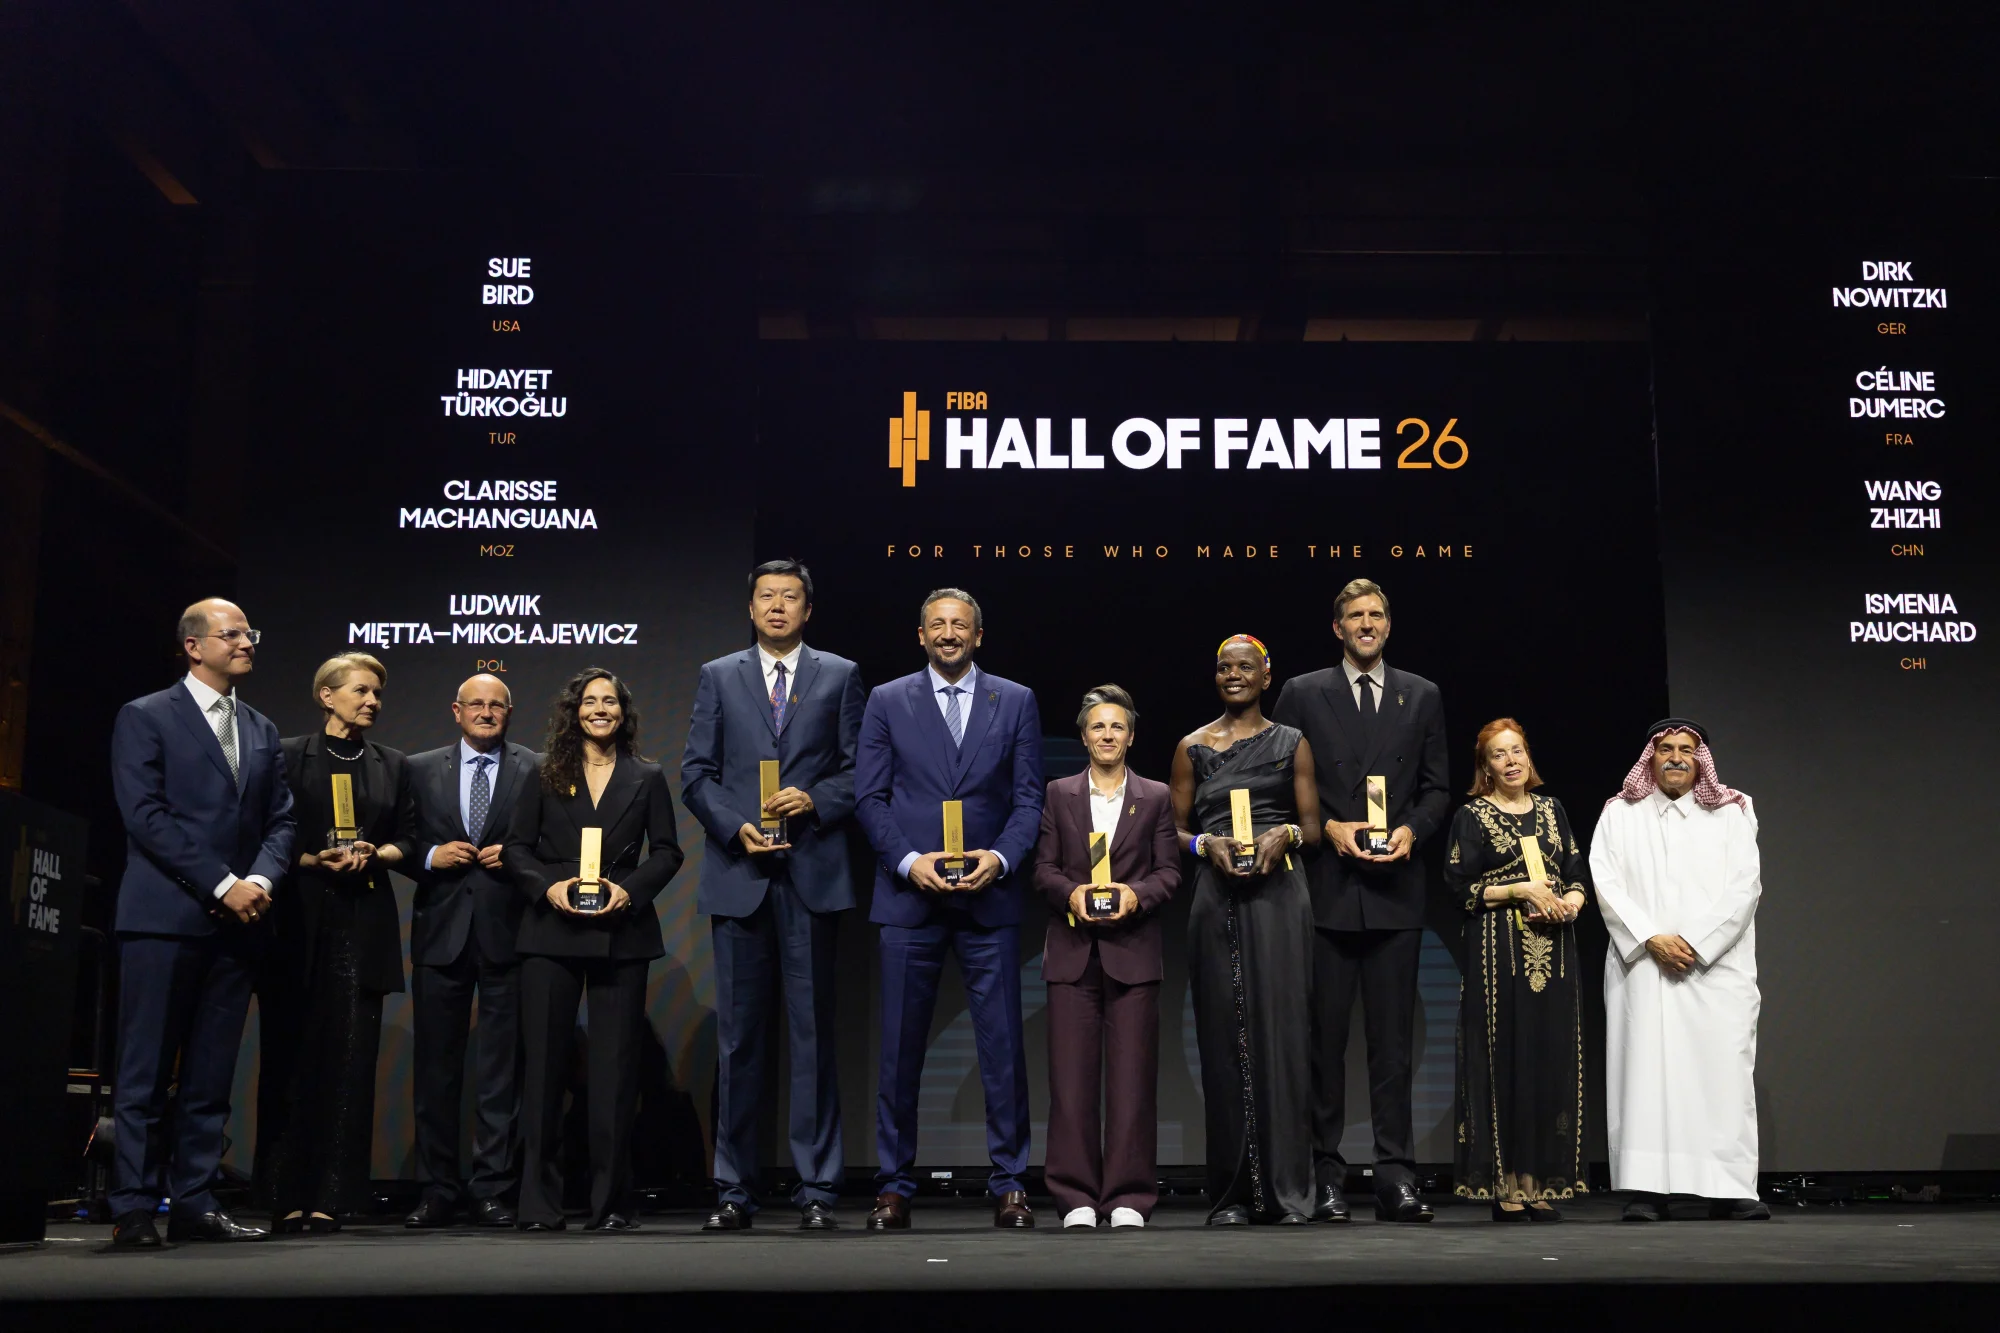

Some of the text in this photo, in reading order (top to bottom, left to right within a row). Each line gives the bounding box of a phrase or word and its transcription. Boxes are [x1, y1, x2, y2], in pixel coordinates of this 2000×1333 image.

[488, 258, 531, 278] SUE
[1863, 261, 1913, 281] DIRK
[483, 285, 534, 305] BIRD
[1833, 288, 1947, 308] NOWITZKI
[493, 320, 520, 331] USA
[1878, 323, 1906, 334] GER
[457, 369, 552, 389] HIDAYET
[1856, 366, 1935, 391] CÉLINE
[441, 392, 566, 417] TÜRKOĞLU
[947, 392, 987, 409] FIBA
[1850, 398, 1945, 418] DUMERC
[489, 433, 515, 444] TUR
[946, 418, 1468, 469] HALL OF FAME 26
[1886, 434, 1913, 444] FRA
[444, 480, 556, 501] CLARISSE
[1864, 481, 1941, 501] WANG
[400, 508, 597, 529] MACHANGUANA
[1870, 508, 1940, 528] ZHIZHI
[481, 545, 514, 556] MOZ
[888, 545, 1472, 557] FOR THOSE WHO MADE THE GAME
[1891, 545, 1923, 556] CHN
[450, 595, 540, 615] LUDWIK
[1865, 594, 1958, 614] ISMENIA
[1851, 622, 1976, 642] PAUCHARD
[478, 660, 507, 672] POL
[1901, 658, 1925, 669] CHI
[32, 848, 62, 880] HALL
[30, 876, 48, 902] OF
[28, 903, 60, 933] FAME
